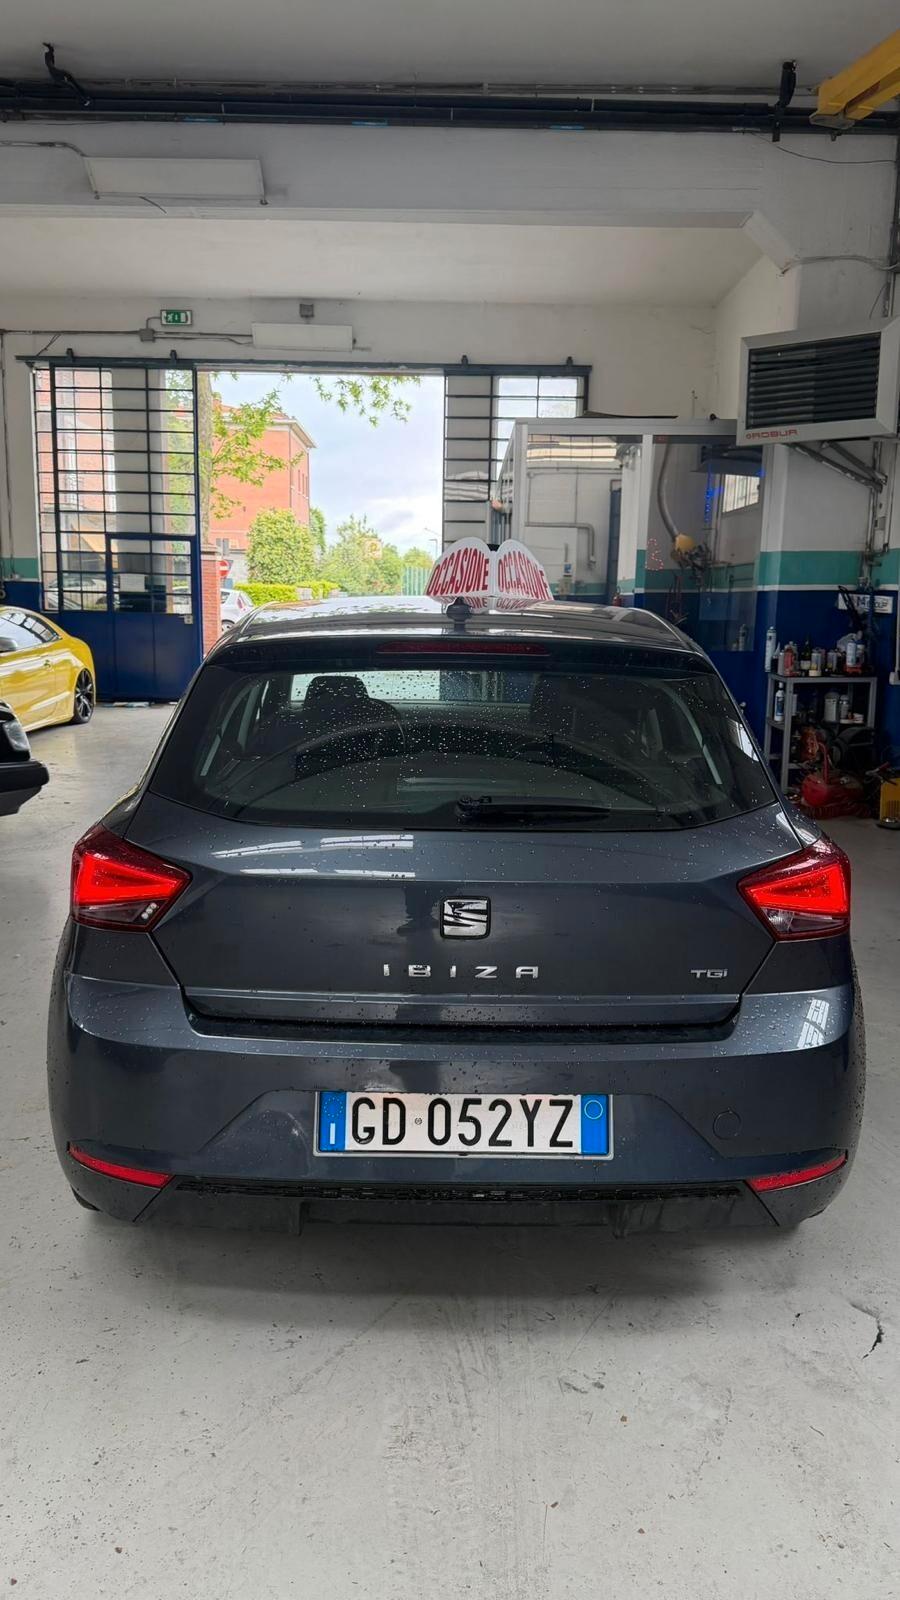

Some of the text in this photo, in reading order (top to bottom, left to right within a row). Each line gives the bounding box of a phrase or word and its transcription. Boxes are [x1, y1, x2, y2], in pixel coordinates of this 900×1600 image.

[426, 547, 489, 596] OCCASIONE
[497, 550, 551, 600] OCCASIONE
[383, 964, 539, 978] IBIZA
[329, 1122, 336, 1145] I
[352, 1097, 573, 1148] GD 052YZ
